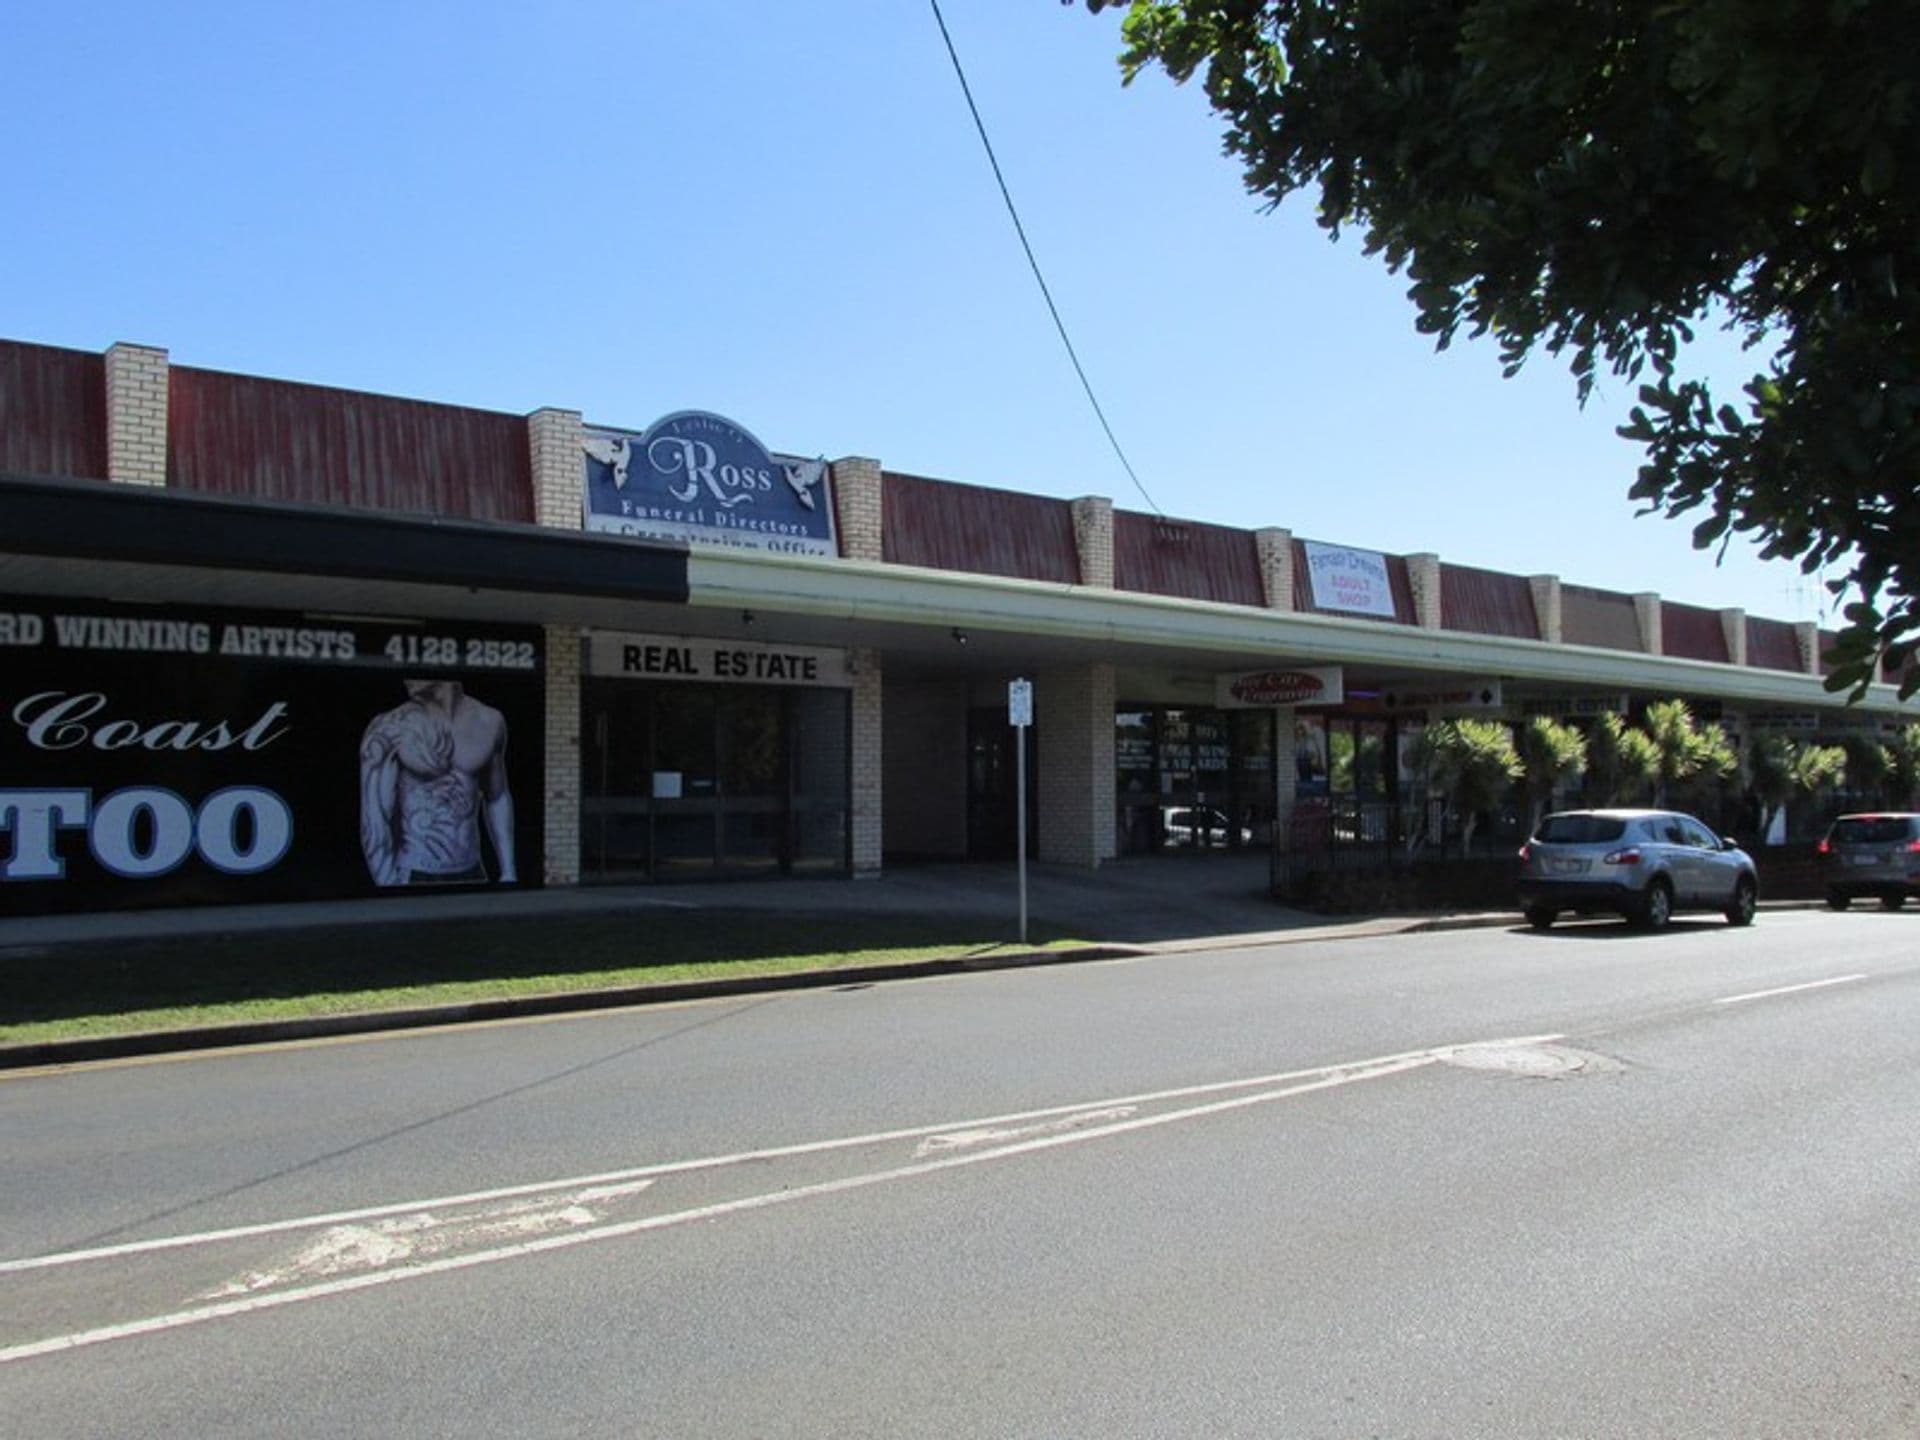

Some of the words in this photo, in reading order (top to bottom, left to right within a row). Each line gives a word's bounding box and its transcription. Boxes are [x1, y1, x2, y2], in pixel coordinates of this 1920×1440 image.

[648, 436, 773, 508] Ross
[621, 500, 705, 523] Funeral
[715, 513, 808, 536] Directors
[54, 615, 210, 653] WINNING
[220, 624, 356, 660] ARTISTS
[384, 634, 459, 665] 4128
[465, 640, 535, 668] 2522
[623, 644, 699, 674] REAL
[714, 650, 817, 680] ESTATE
[12, 691, 292, 750] Coast
[0, 785, 294, 879] TOO
